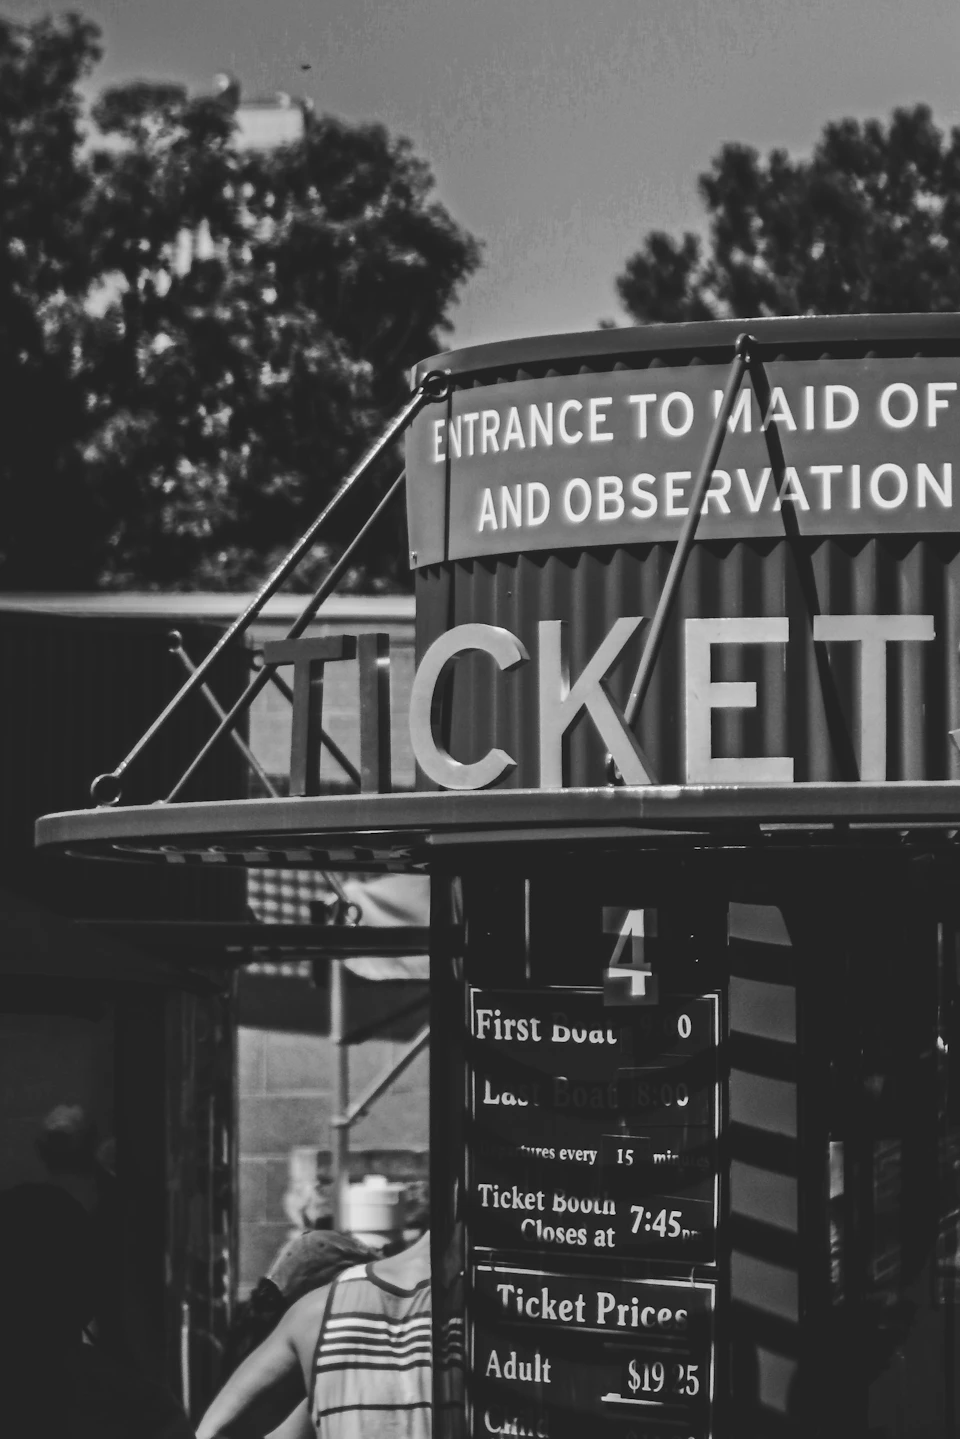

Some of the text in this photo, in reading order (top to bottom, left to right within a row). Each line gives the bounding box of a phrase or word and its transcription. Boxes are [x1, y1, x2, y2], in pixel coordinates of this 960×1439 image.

[433, 395, 614, 463] ENTRANCE
[629, 391, 694, 438] TO
[714, 384, 860, 433] MAID
[880, 382, 958, 428] OF
[478, 481, 551, 532] AND
[563, 462, 953, 523] OBSERVATION
[608, 909, 653, 996] 4
[476, 1009, 542, 1042] First
[559, 1146, 598, 1166] every
[617, 1148, 634, 1166] 15
[478, 1183, 545, 1211] Ticket
[521, 1218, 616, 1248] Closes at
[496, 1283, 689, 1329] Ticket Prices
[485, 1349, 552, 1383] Adult
